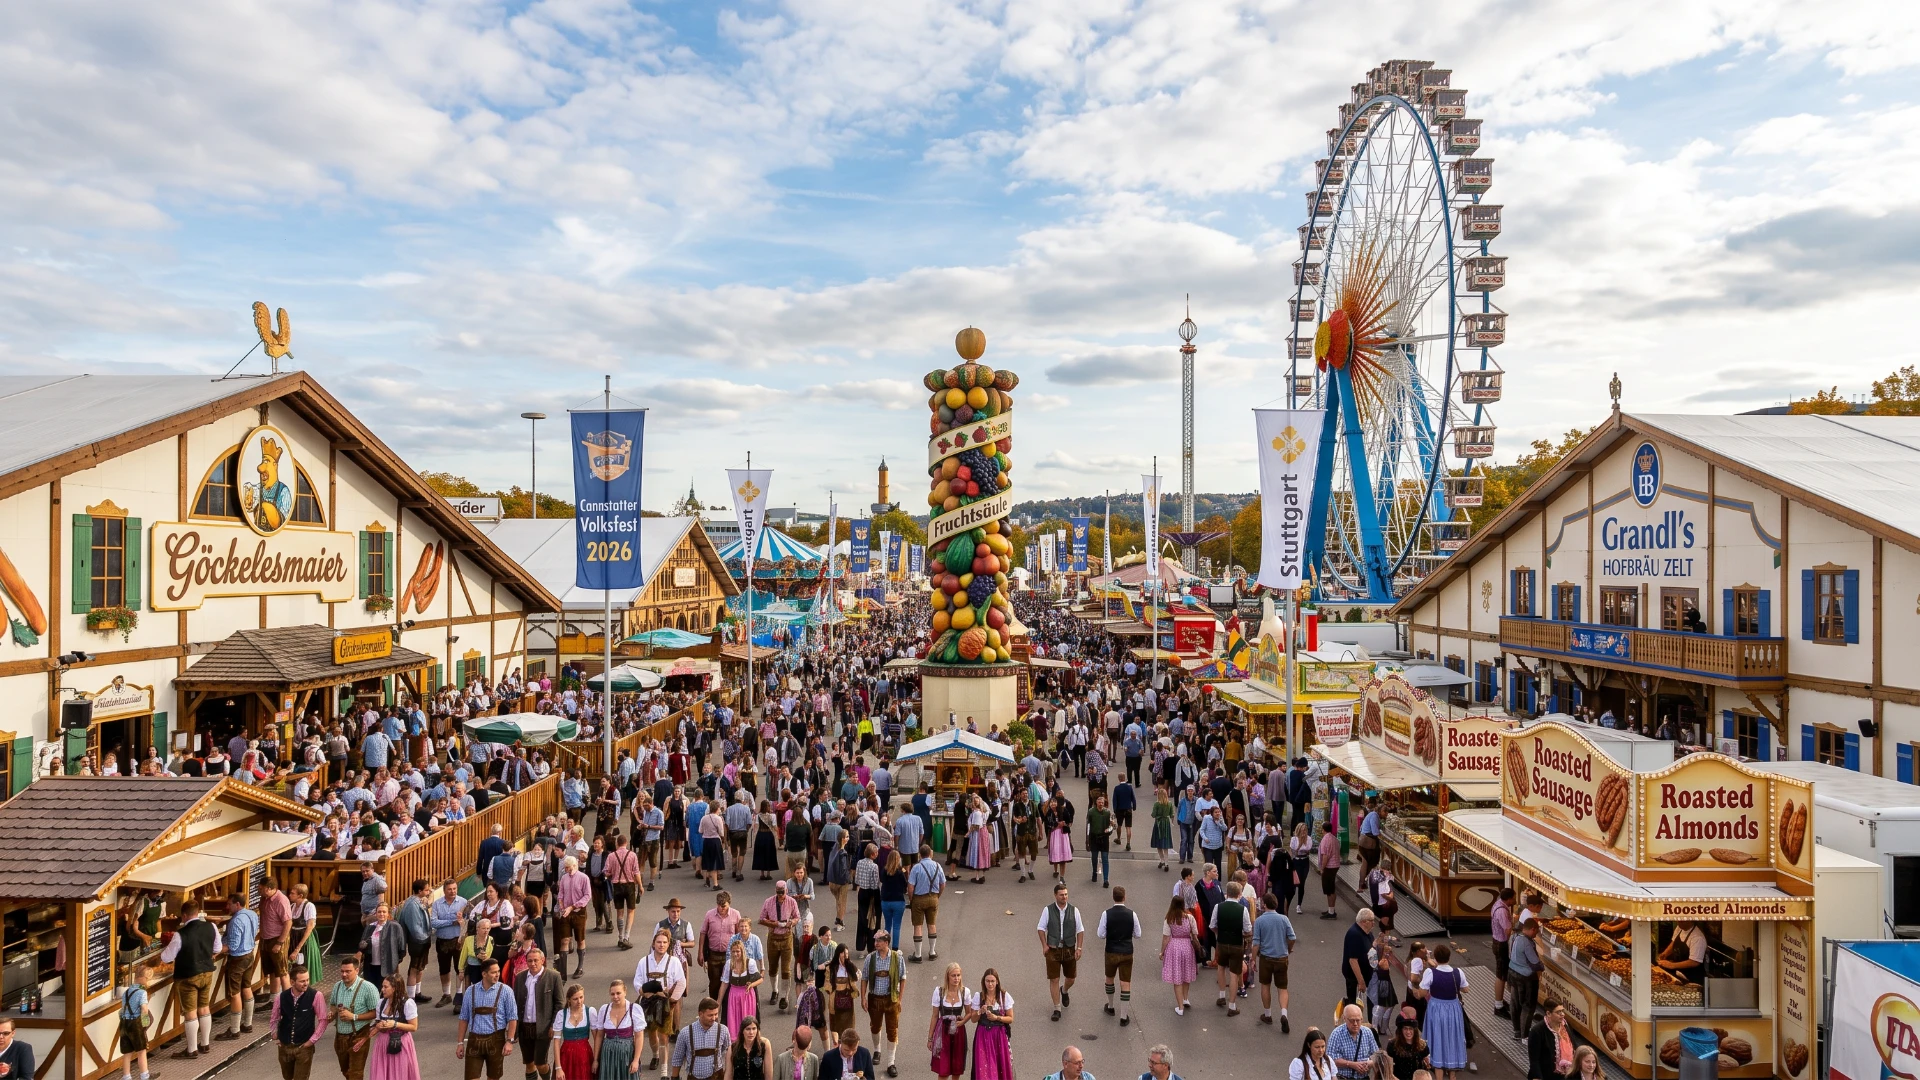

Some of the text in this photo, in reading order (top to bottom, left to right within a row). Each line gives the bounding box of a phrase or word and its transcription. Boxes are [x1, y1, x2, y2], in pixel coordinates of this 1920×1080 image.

[580, 498, 638, 512] Cannstatter
[934, 496, 1008, 538] Fruchtsäule
[580, 514, 638, 533] Volksfest
[1280, 474, 1303, 577] Stuttgart
[1602, 510, 1695, 551] Grandl's
[586, 540, 632, 562] 2026
[165, 531, 348, 602] Göckelesmaier
[1603, 555, 1694, 577] HOFBRÄU ZELT
[1447, 727, 1501, 748] Roaste
[1448, 750, 1501, 776] Sausag
[1534, 736, 1592, 783] Roasted
[1532, 766, 1593, 821] Sausage
[1660, 783, 1754, 809] Roasted
[1655, 814, 1759, 840] Almonds
[1723, 903, 1786, 915] Almonds
